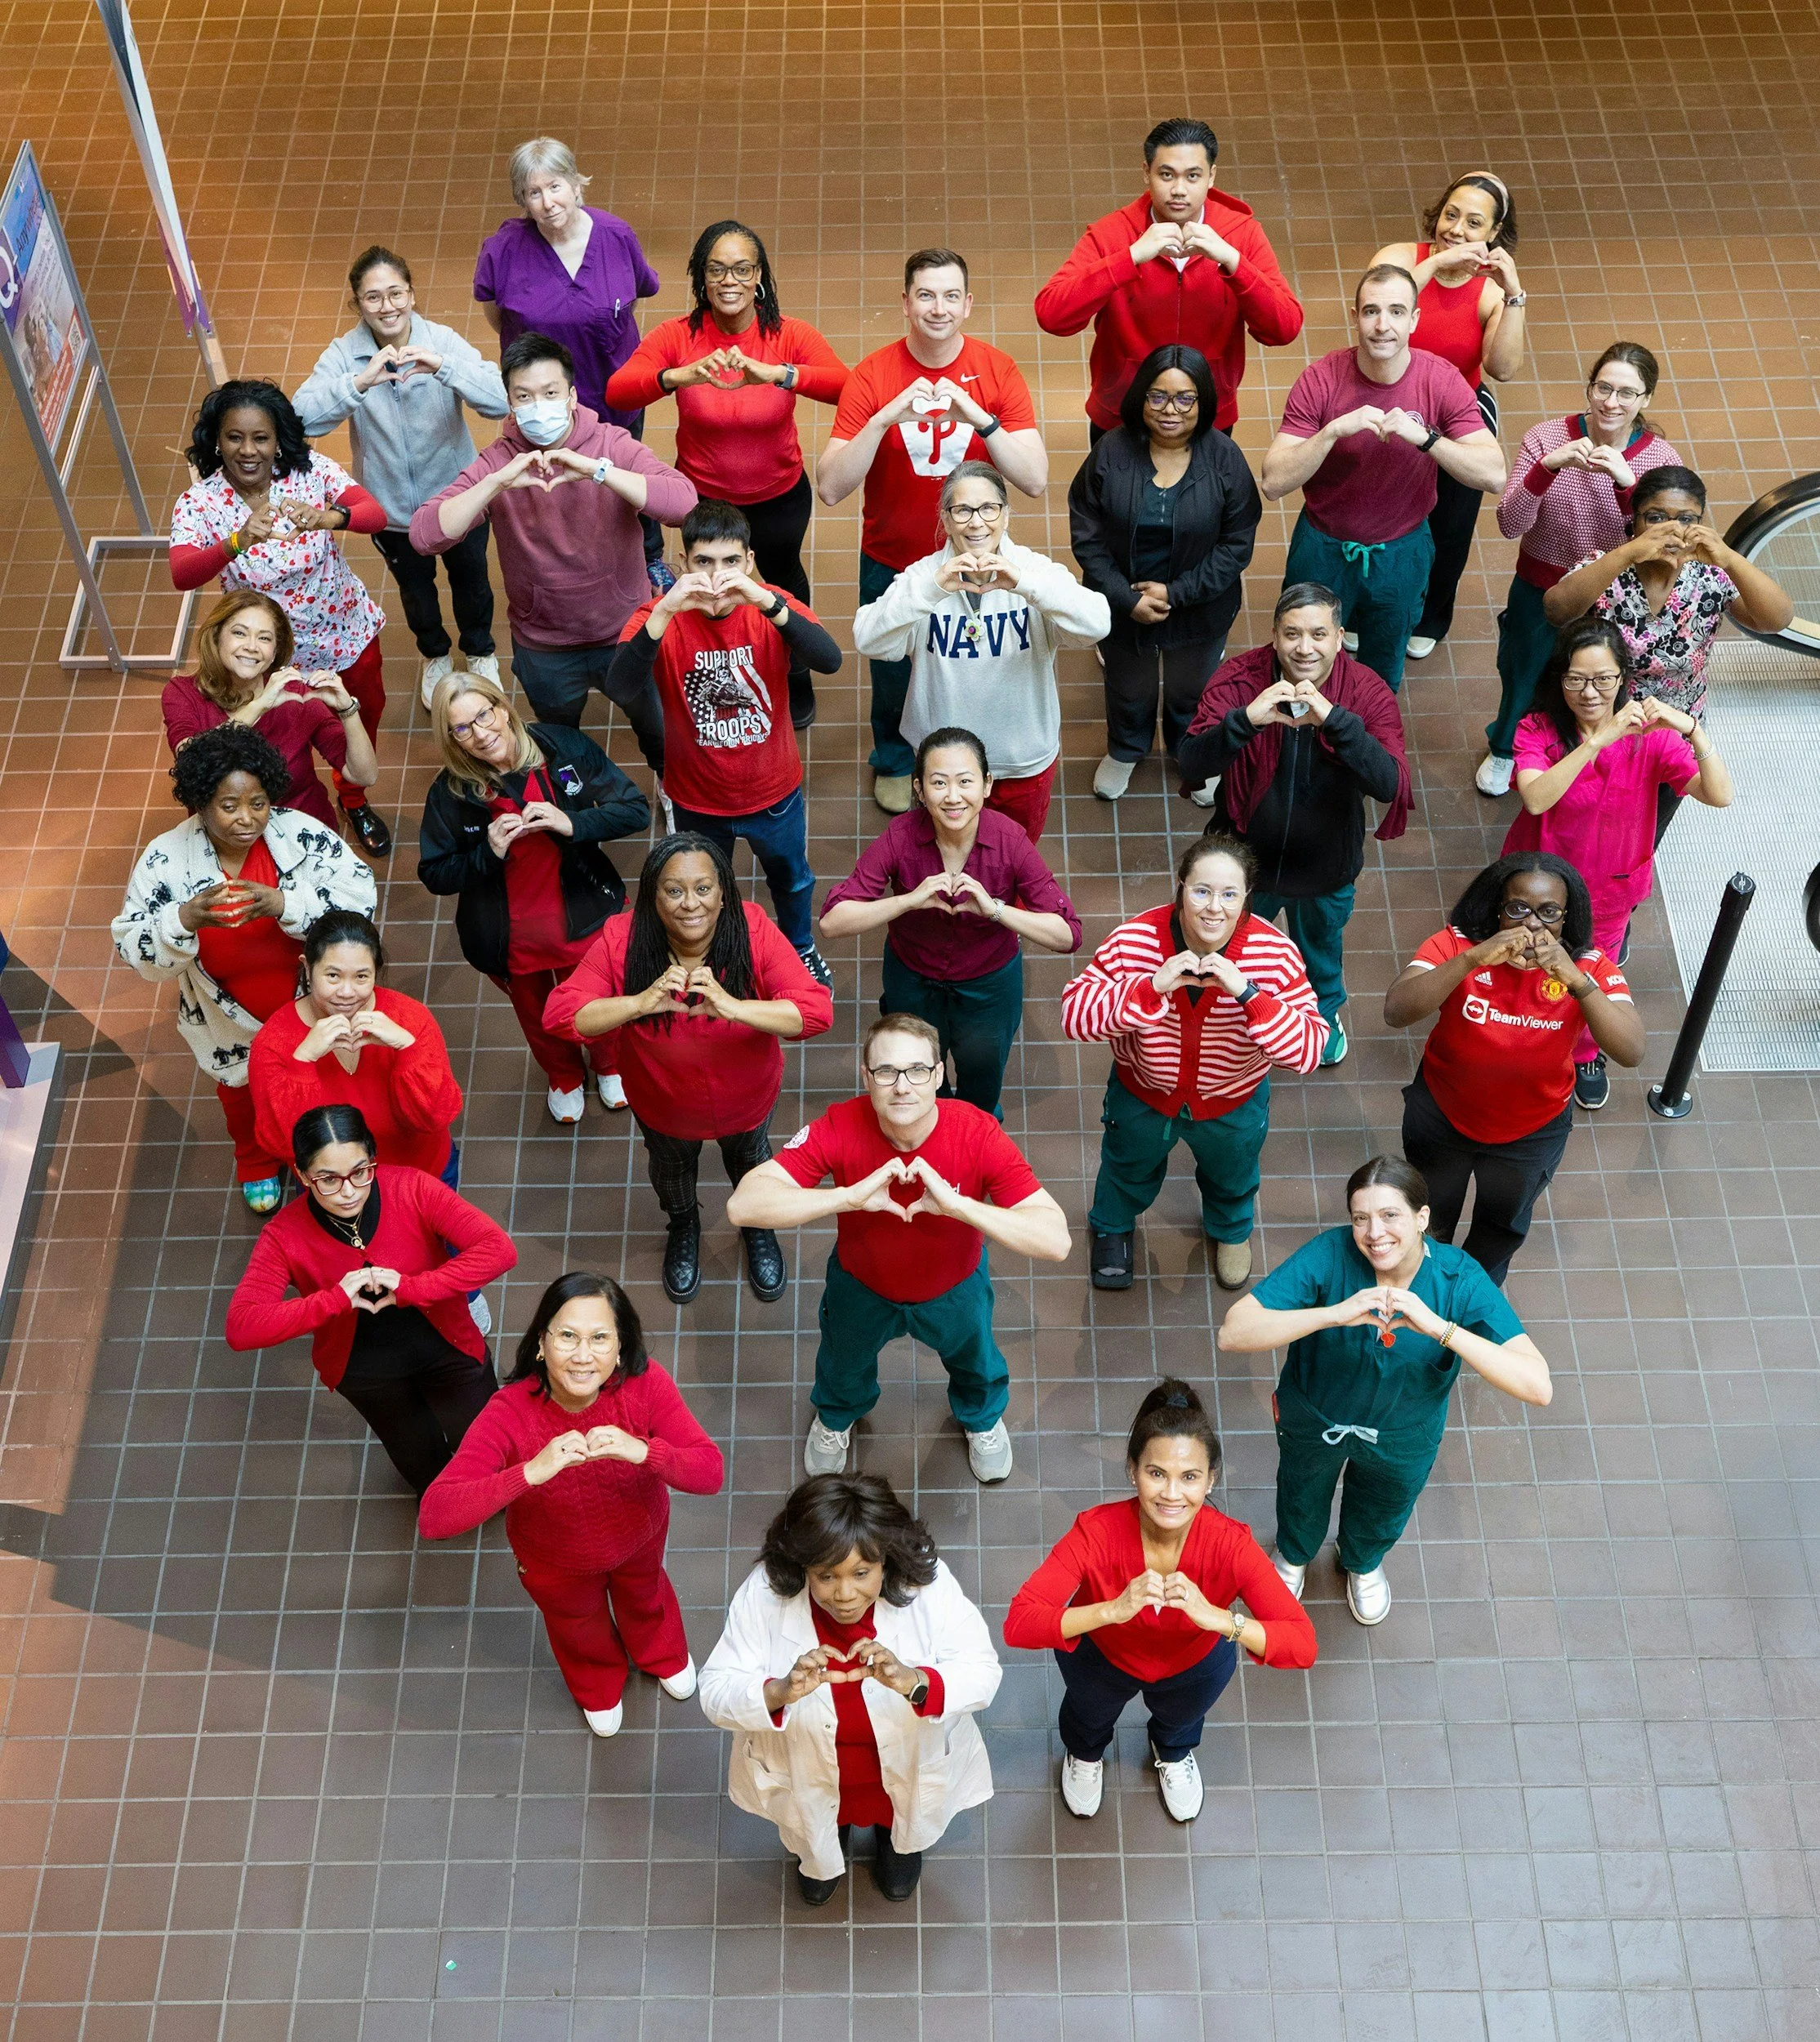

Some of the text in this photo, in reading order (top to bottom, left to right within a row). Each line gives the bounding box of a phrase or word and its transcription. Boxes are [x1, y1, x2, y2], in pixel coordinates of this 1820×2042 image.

[927, 607, 1029, 658] NAVY
[694, 645, 753, 670] SUPPORT
[696, 714, 761, 741] TROOPS
[1488, 1008, 1564, 1030] TeamViewer
